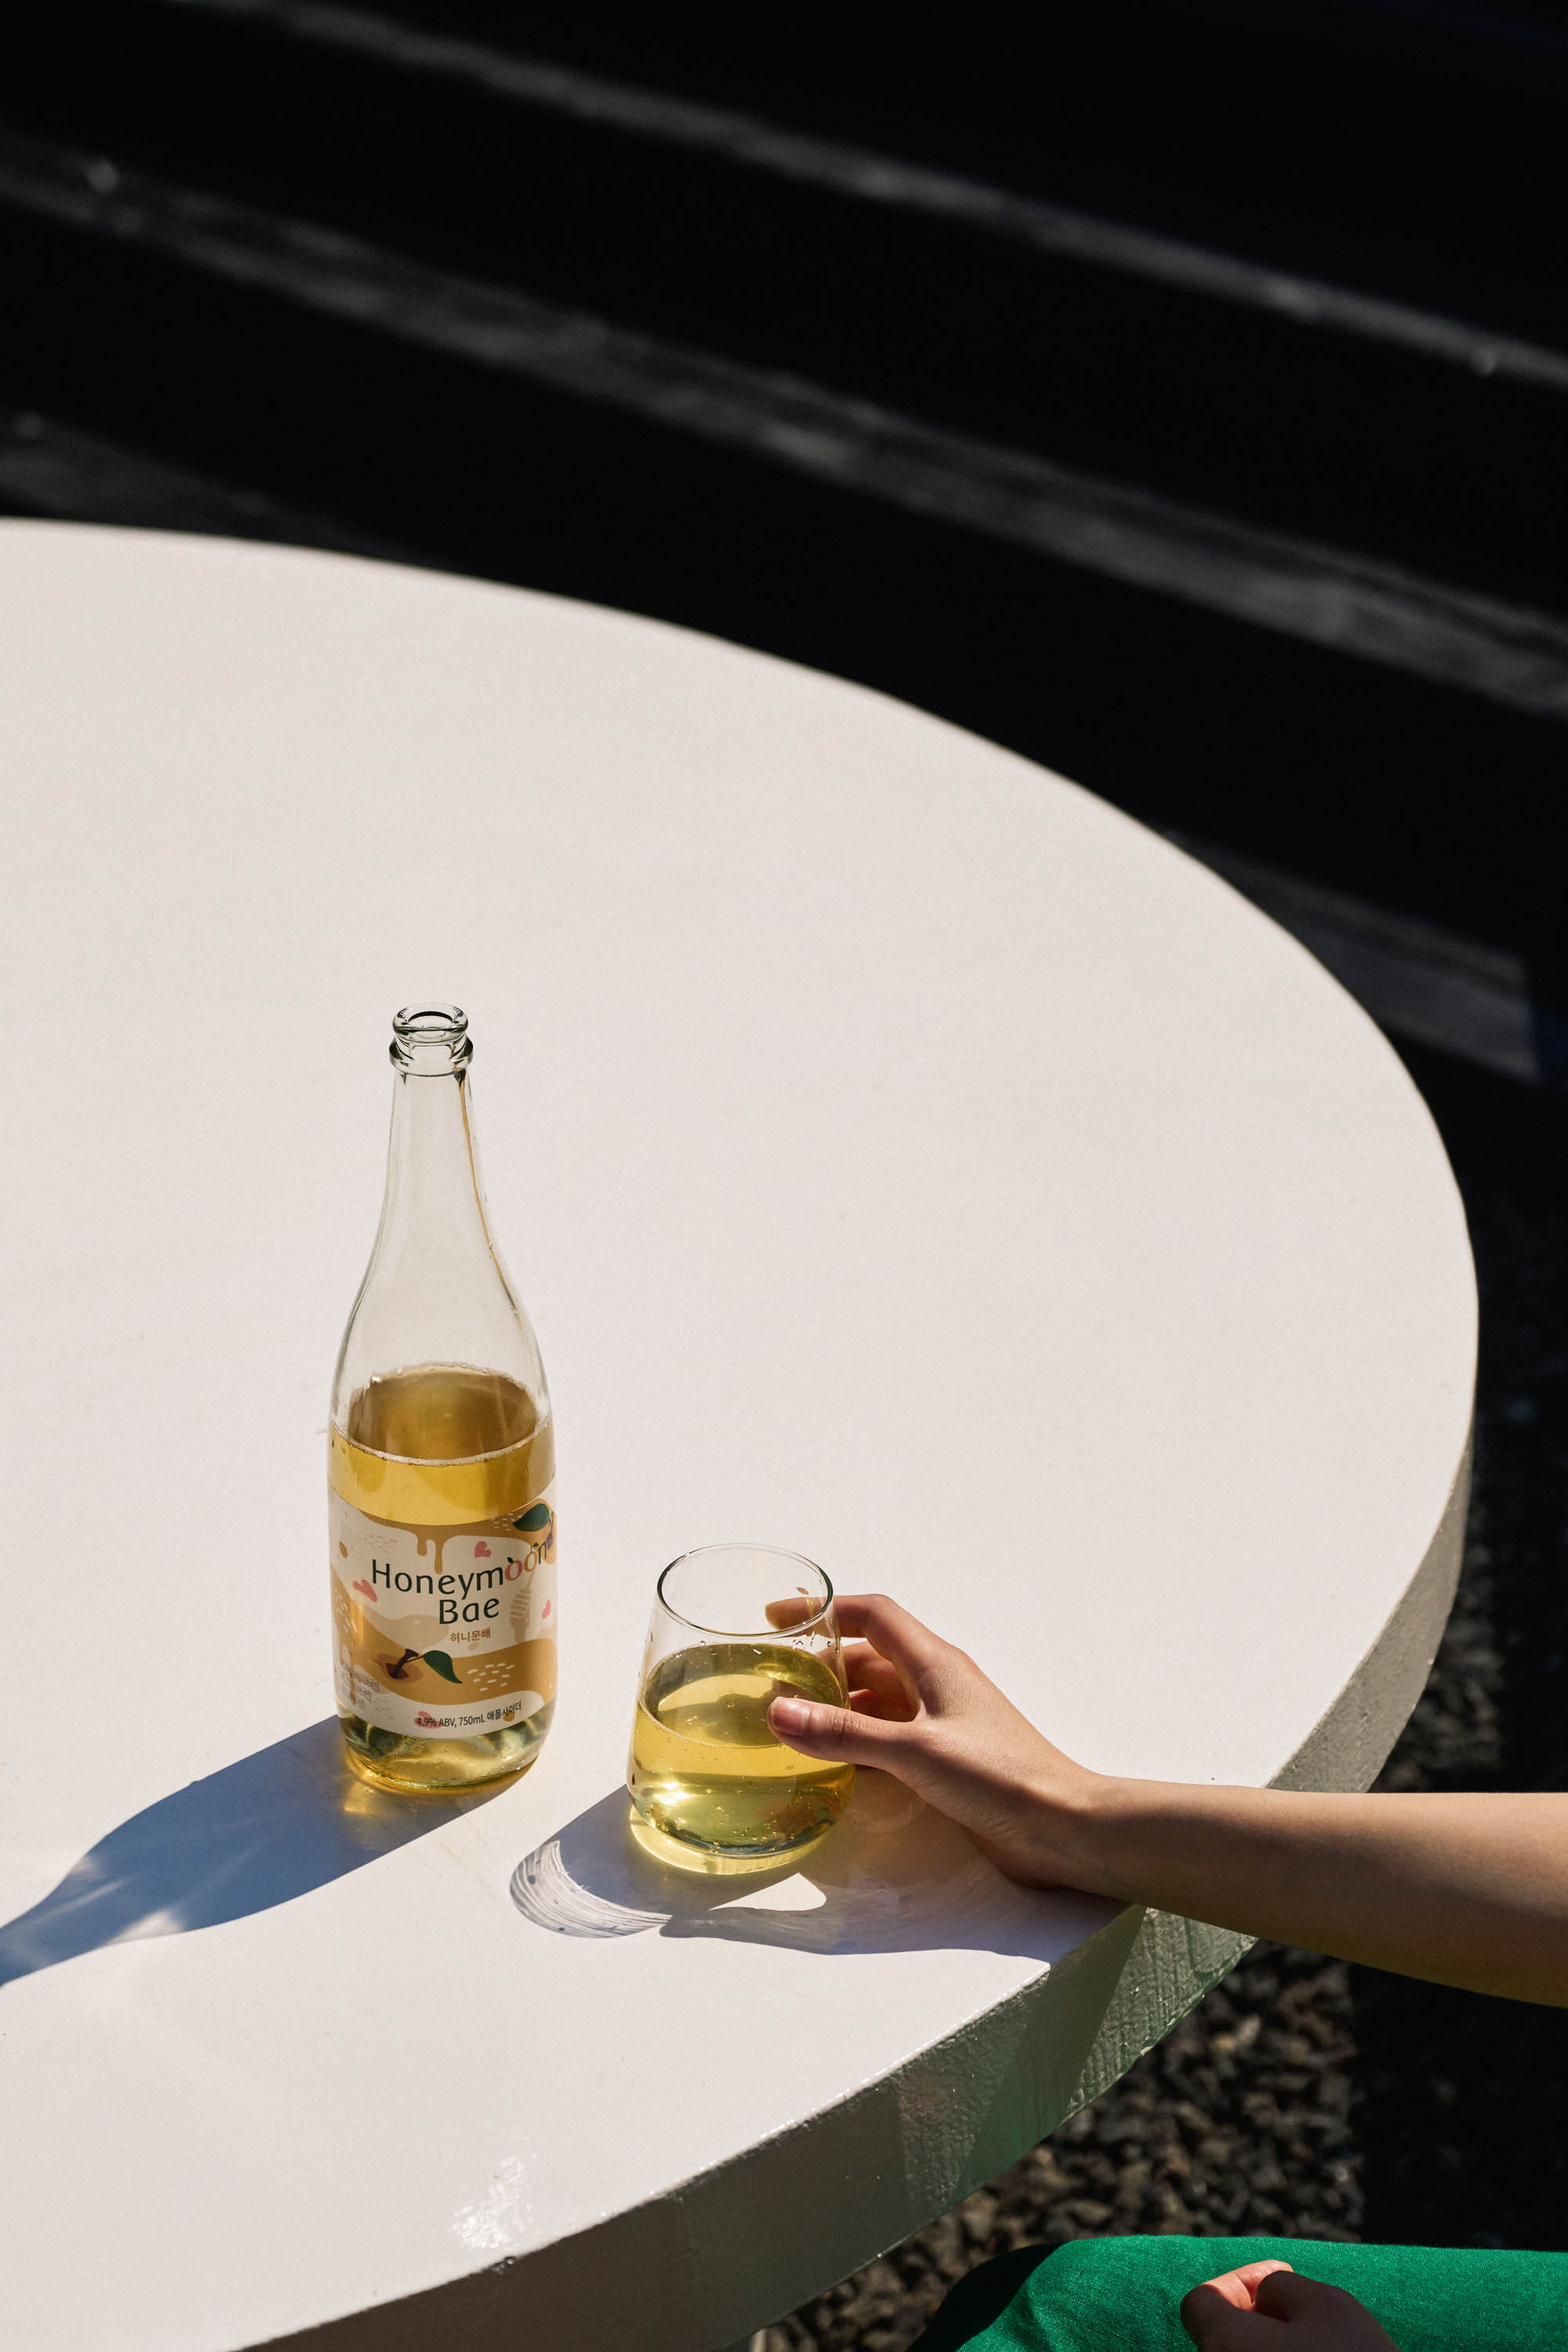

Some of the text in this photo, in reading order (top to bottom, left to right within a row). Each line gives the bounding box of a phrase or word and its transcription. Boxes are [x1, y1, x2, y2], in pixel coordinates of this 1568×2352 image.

[372, 1541, 547, 1600] Honeymoon
[439, 1598, 500, 1624] Bae
[450, 1628, 491, 1643] 허니문배
[416, 1700, 521, 1728] 4.9% ABV, 750mL 애플사이더
